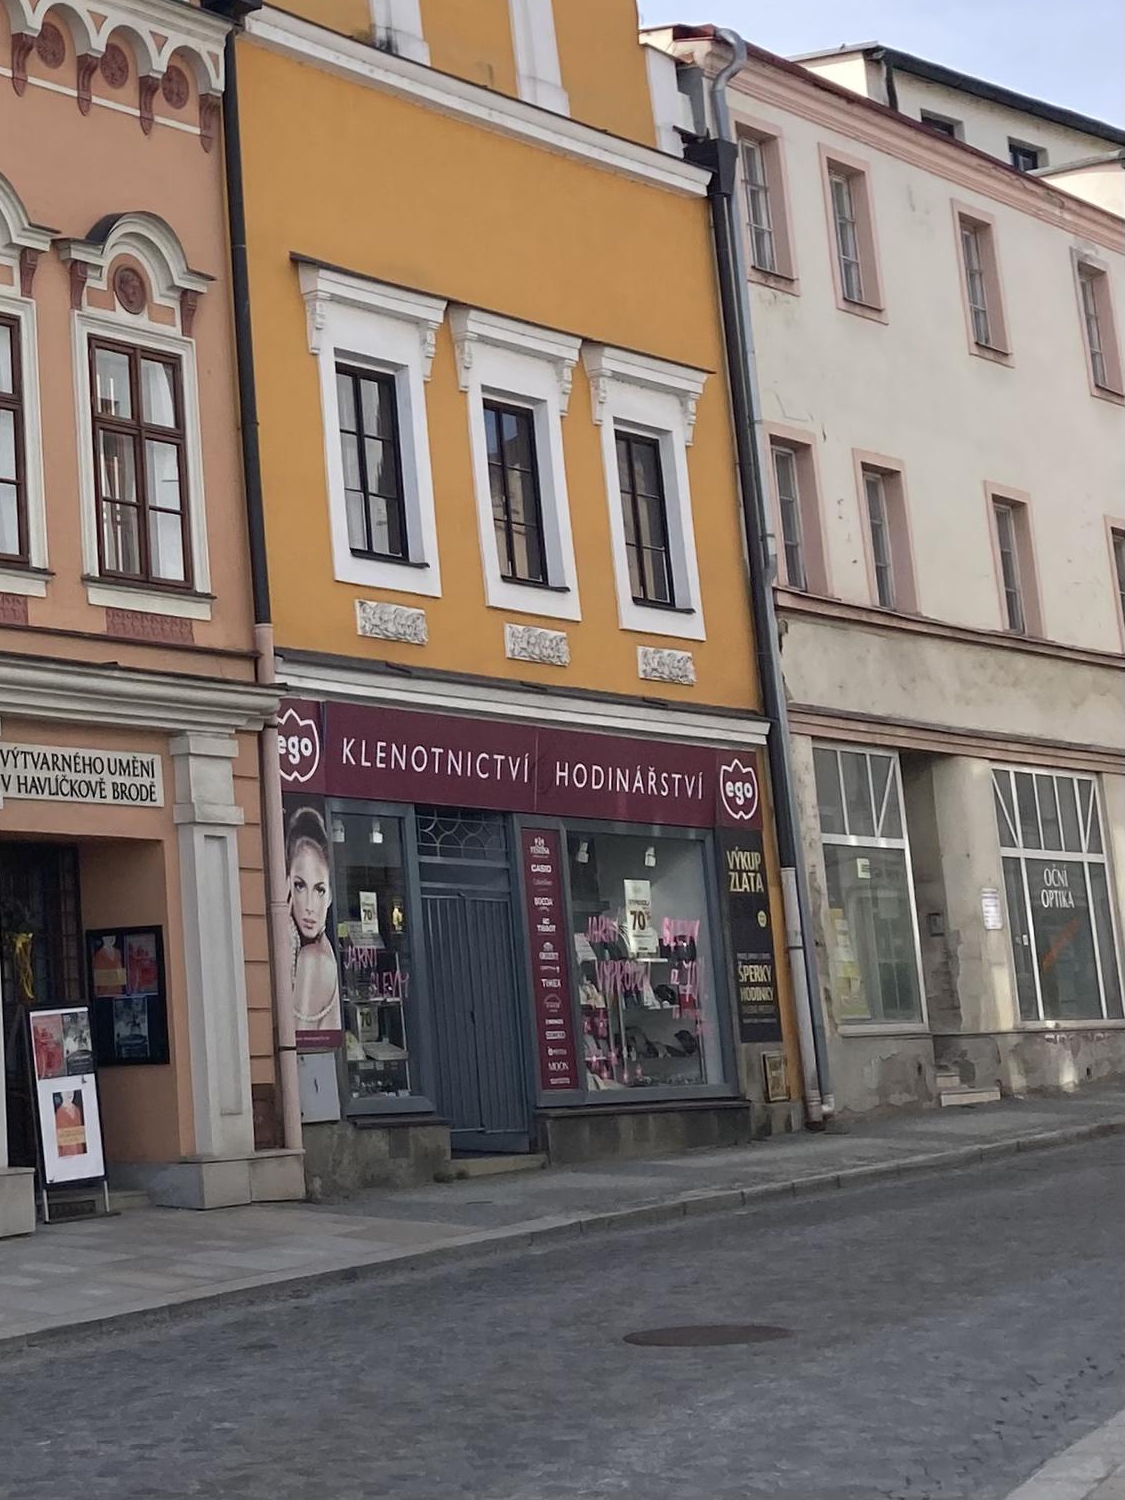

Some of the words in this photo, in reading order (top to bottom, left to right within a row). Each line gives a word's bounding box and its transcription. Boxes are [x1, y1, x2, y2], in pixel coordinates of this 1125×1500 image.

[277, 735, 313, 765] ego
[342, 737, 530, 783] KLENOTNICTVÍ
[0, 747, 105, 775] VÝTVARNÉHO
[107, 756, 155, 779] UMĚNÍ
[0, 774, 11, 792] V
[16, 774, 107, 799] HAVLÍČKOVĚ
[112, 781, 157, 802] BRODĚ
[556, 761, 703, 800] HODINÁŘSTVÍ
[725, 781, 753, 805] ego
[727, 846, 761, 871] VÝKUP
[729, 872, 764, 893] ZLATA
[1044, 863, 1069, 888] OČNÍ
[1041, 889, 1075, 909] OPTIKA
[738, 961, 772, 983] ŠPERKY
